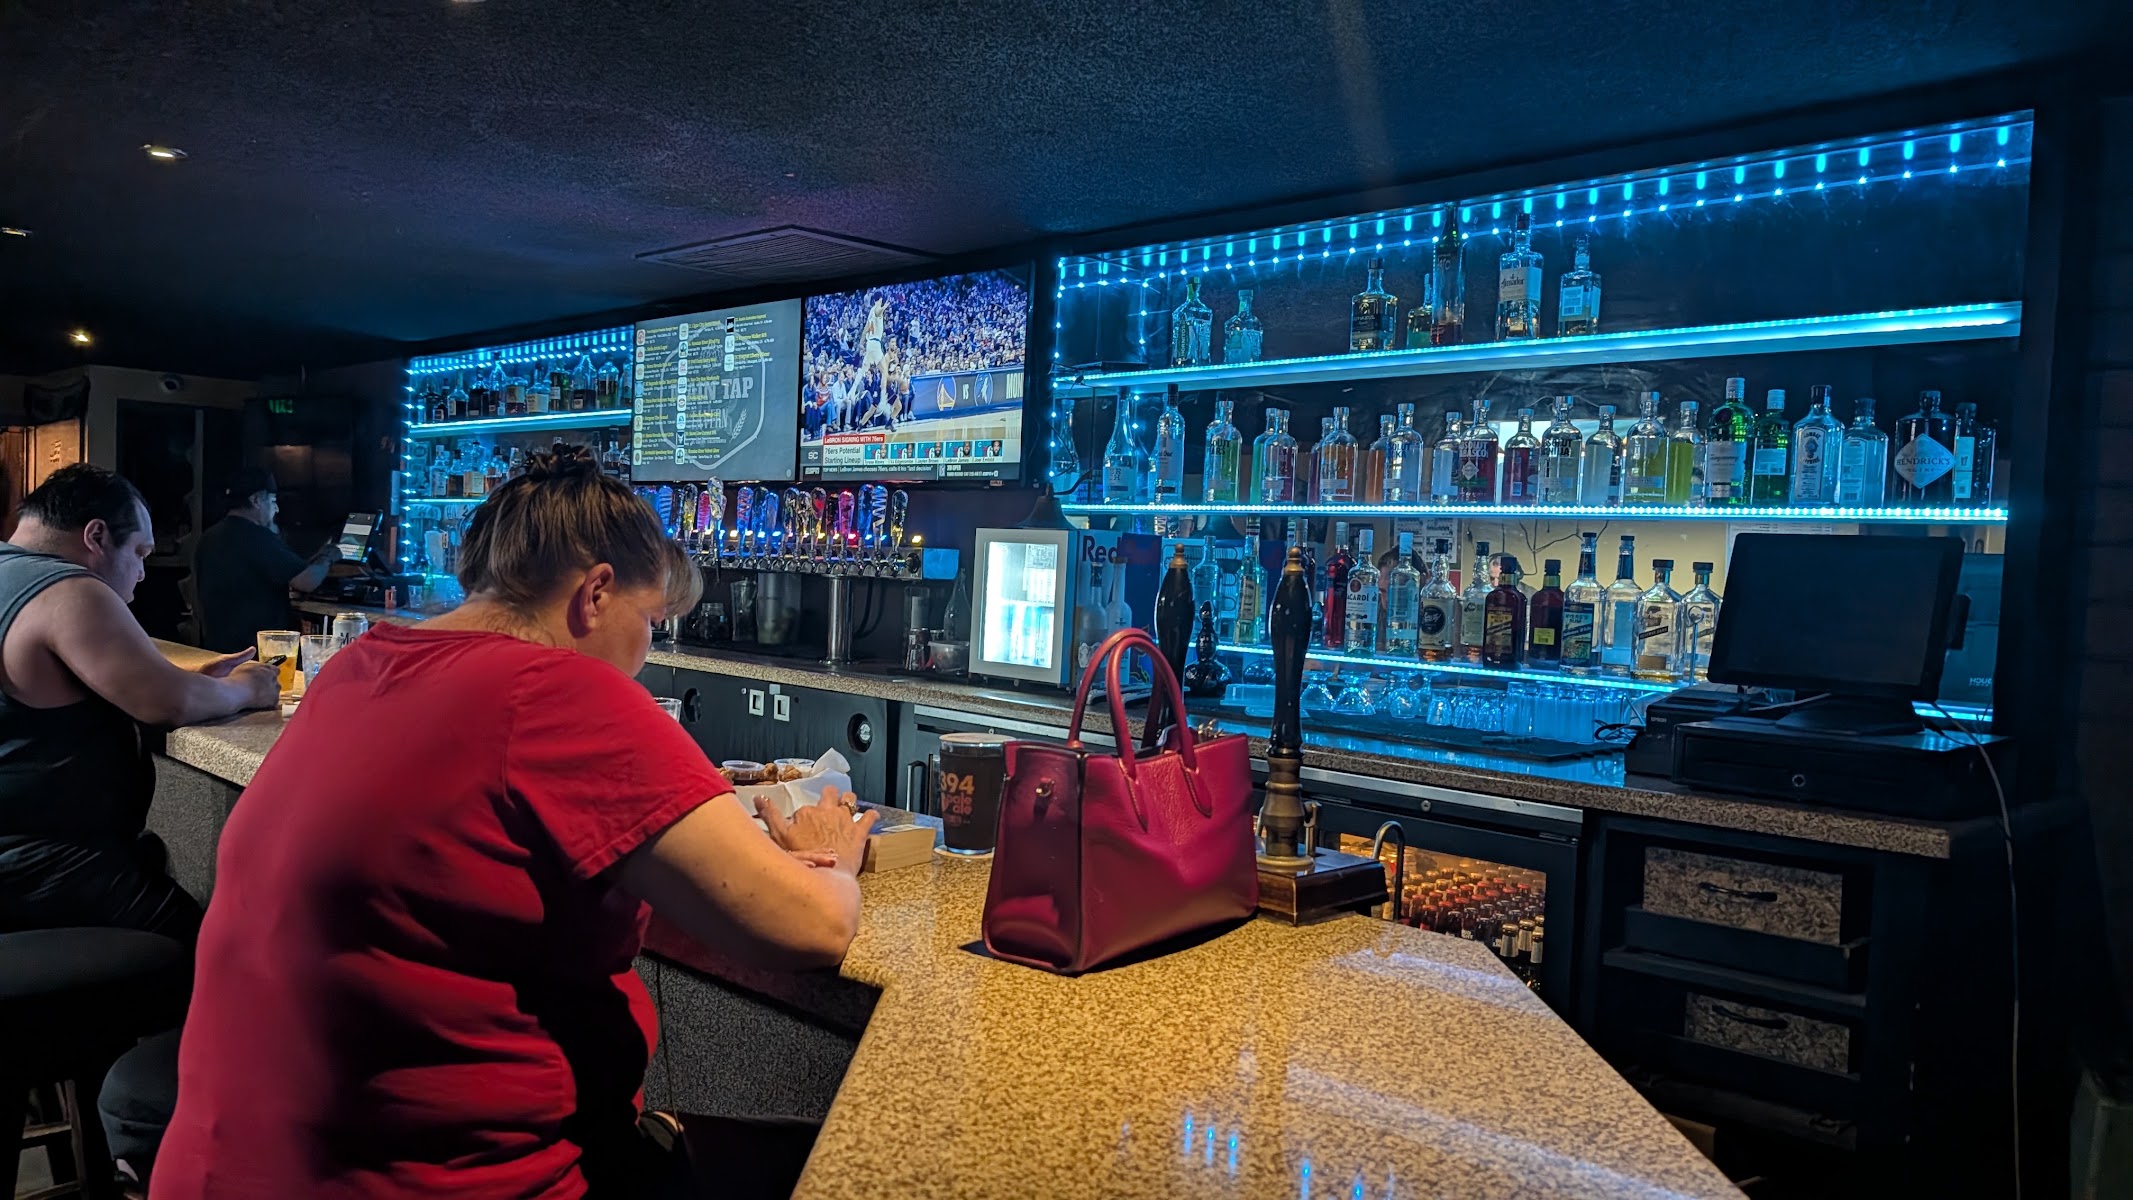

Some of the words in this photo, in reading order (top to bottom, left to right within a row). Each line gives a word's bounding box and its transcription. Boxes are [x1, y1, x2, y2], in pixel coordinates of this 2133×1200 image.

[721, 377, 754, 399] TAP
[839, 446, 860, 454] Potential
[844, 456, 861, 464] Lineup
[1896, 457, 1951, 466] HENDRICK'S
[805, 467, 820, 475] ESPN
[1082, 536, 1122, 563] Red
[941, 770, 975, 796] 394
[947, 792, 972, 806] pale
[953, 803, 972, 815] ale
